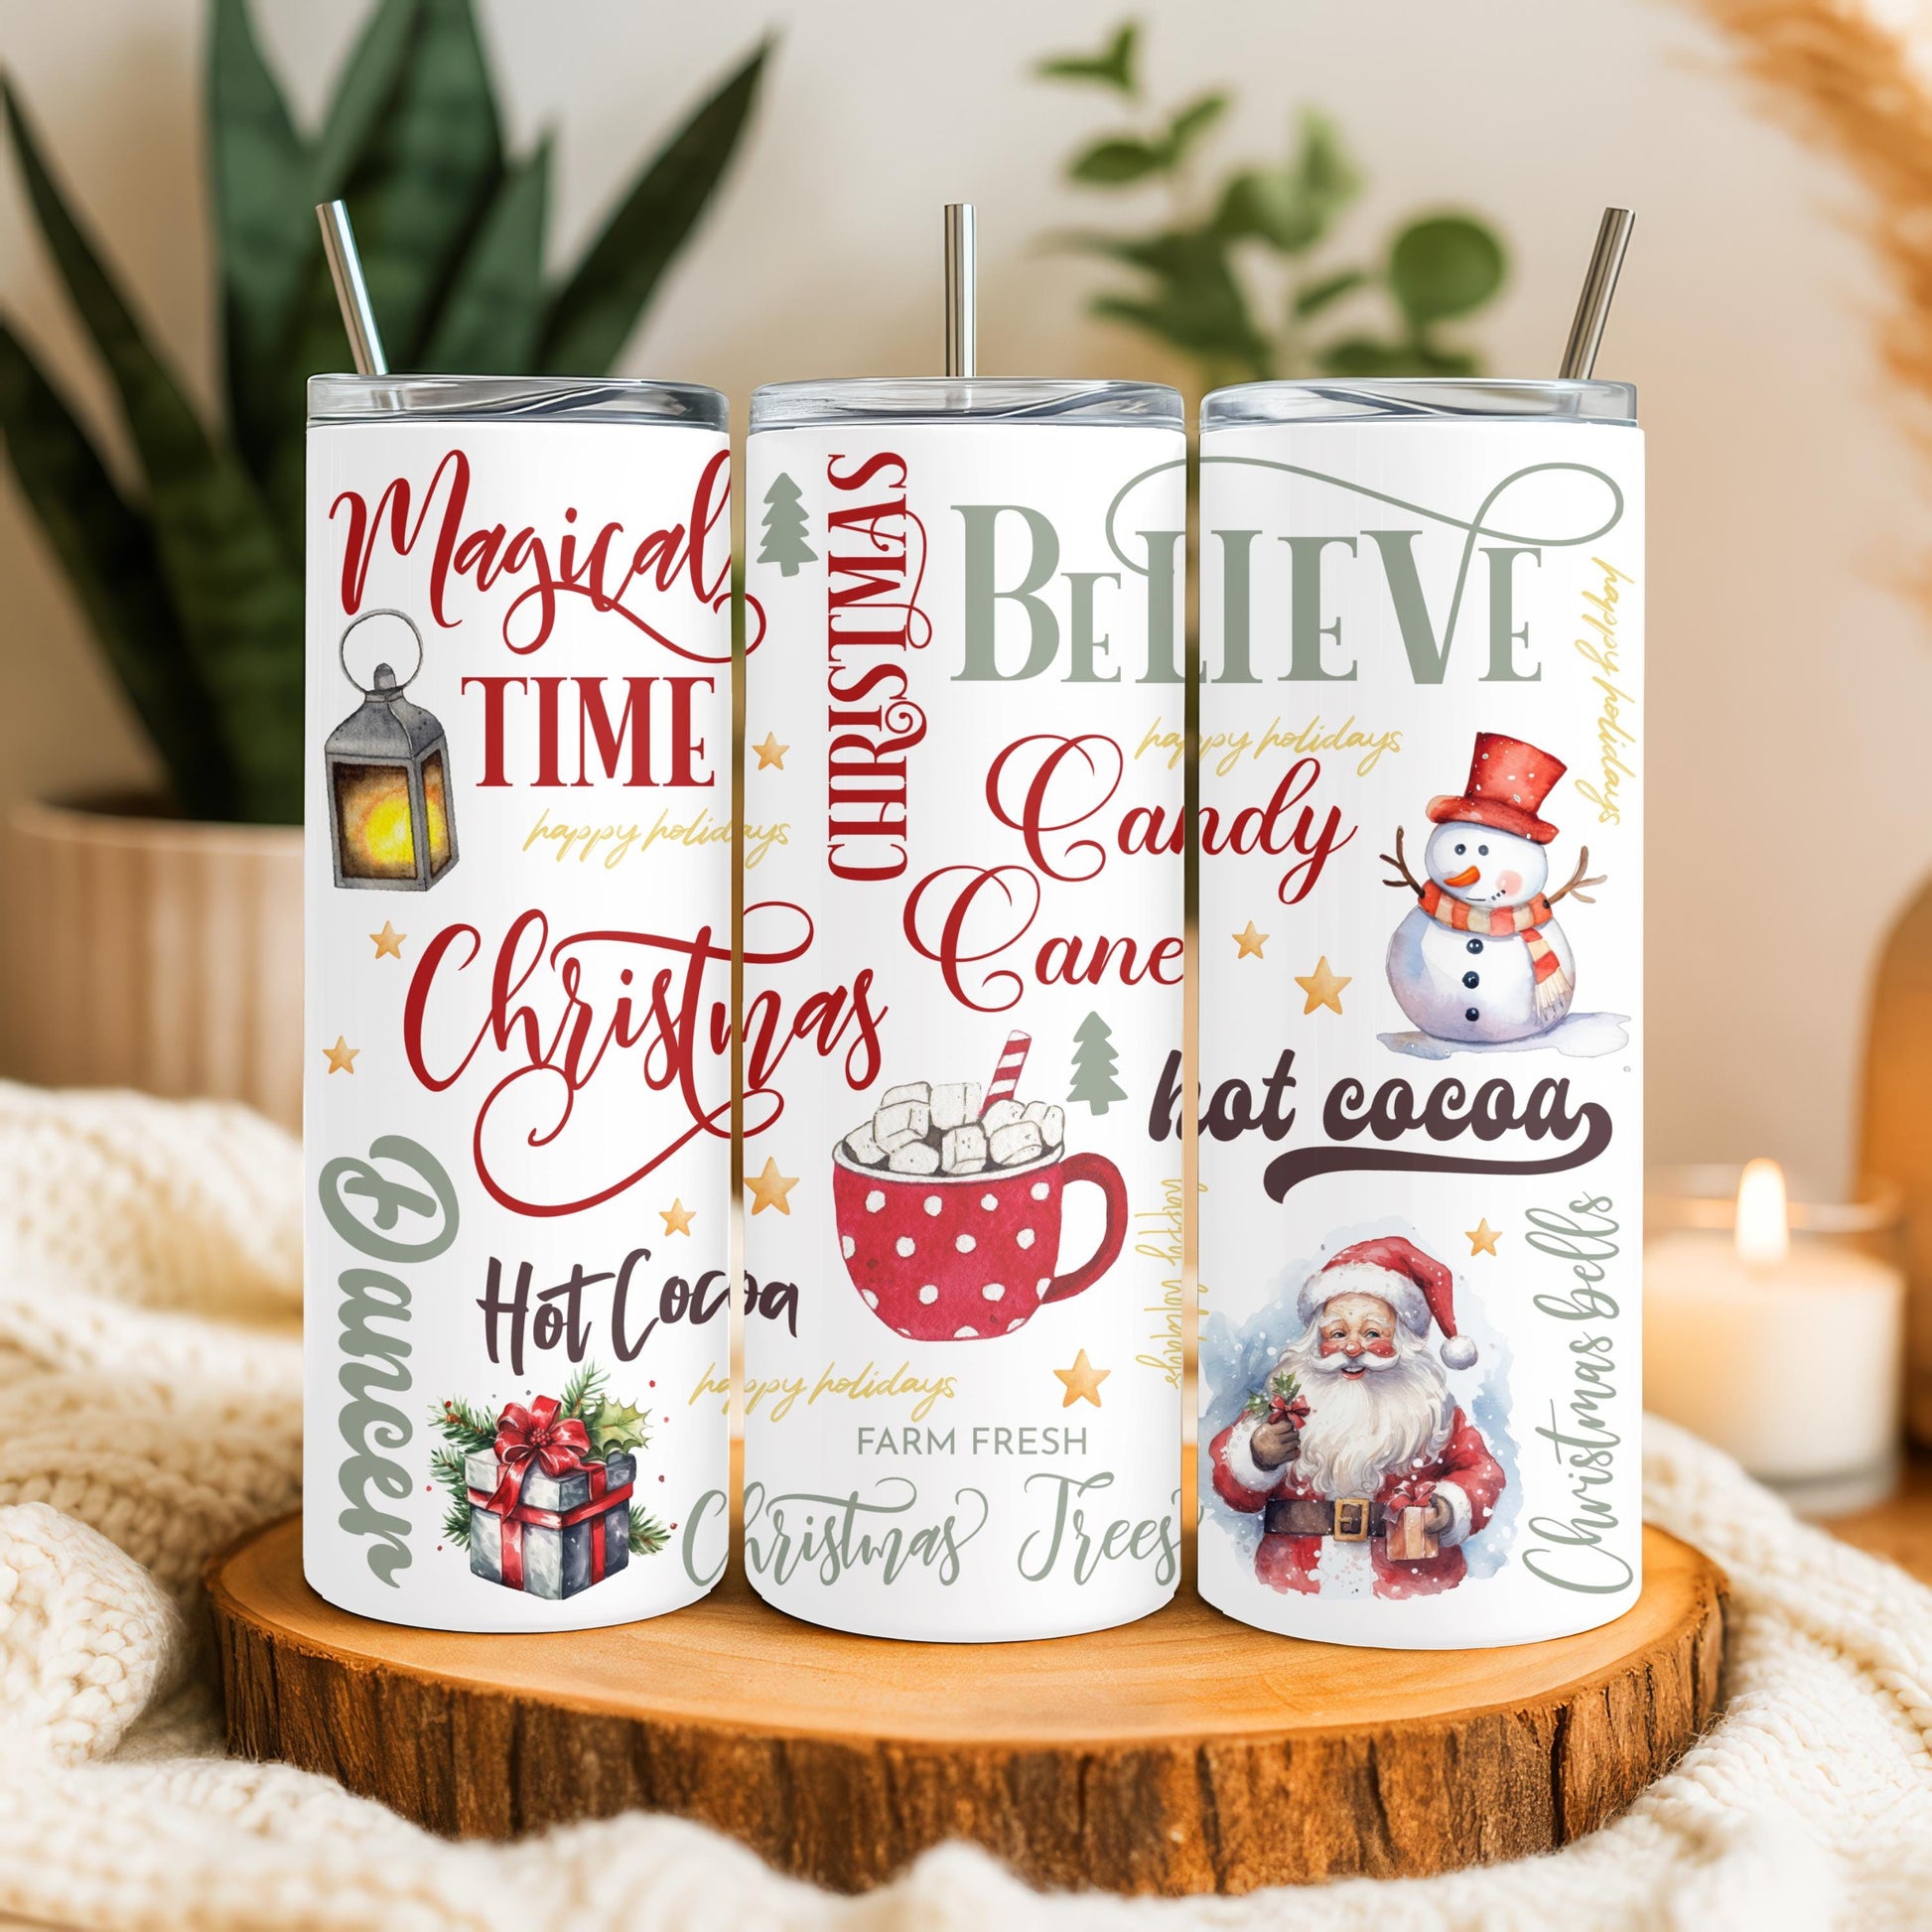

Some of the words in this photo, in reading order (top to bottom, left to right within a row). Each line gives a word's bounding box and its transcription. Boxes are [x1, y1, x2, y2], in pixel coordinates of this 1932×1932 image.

[329, 449, 767, 664] Magical
[1575, 556, 1635, 677] happy
[461, 676, 715, 787] TIME
[827, 452, 933, 882] CHRISTMAS
[1134, 716, 1254, 777] happy
[1253, 715, 1404, 777] holidays
[1575, 675, 1636, 826] holidays
[522, 808, 642, 870] happy
[985, 734, 1358, 905] Candy
[902, 865, 1184, 1013] Cane
[403, 900, 889, 1218] Christmas
[1148, 1048, 1297, 1142] hot
[476, 1256, 616, 1376] Hot
[611, 1248, 799, 1362] Cocoa
[1524, 1191, 1620, 1321] bells
[318, 1134, 461, 1588] Dancer
[688, 1361, 808, 1423] happy
[807, 1360, 958, 1424] holidays
[858, 1427, 955, 1455] FARM
[972, 1427, 1086, 1455] FRESH
[1522, 1331, 1634, 1594] Christmas
[681, 1477, 989, 1587] Christmas
[1018, 1471, 1205, 1587] Trees
